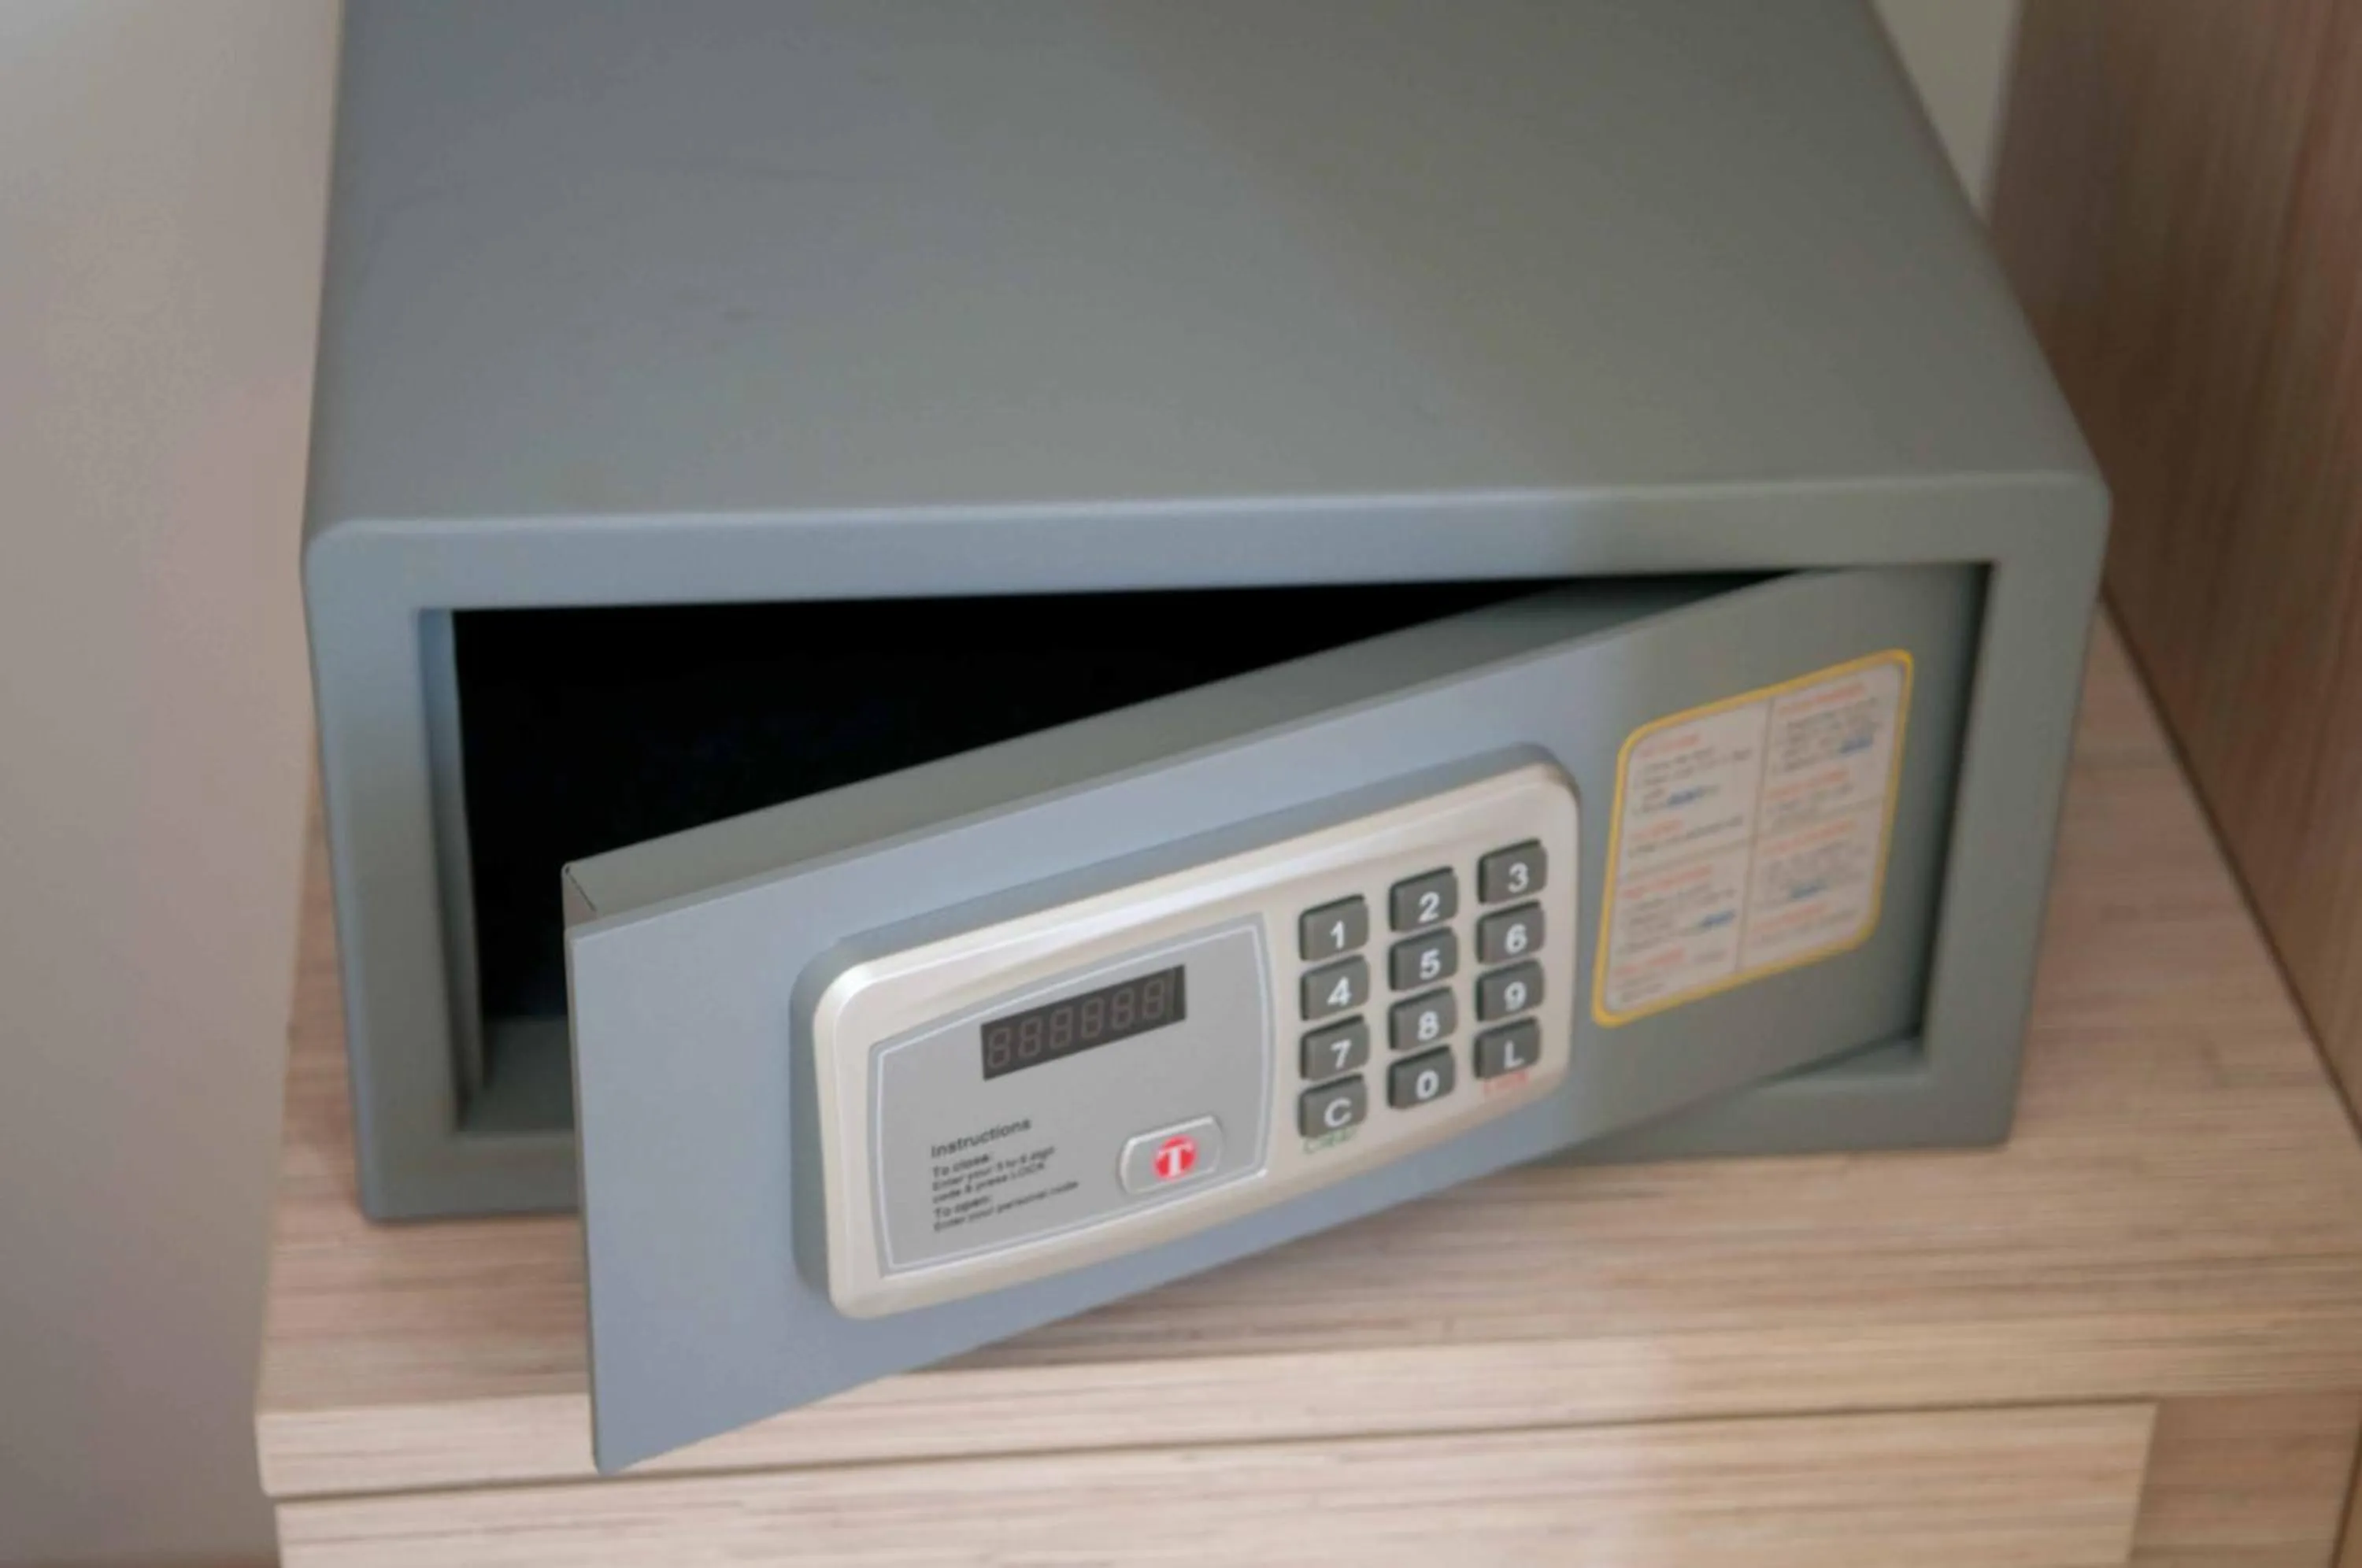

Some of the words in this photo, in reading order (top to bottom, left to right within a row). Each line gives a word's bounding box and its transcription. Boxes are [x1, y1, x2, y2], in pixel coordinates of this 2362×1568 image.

[1331, 921, 1345, 949] 1
[1420, 892, 1440, 923] 2
[1508, 863, 1529, 893] 3
[1327, 978, 1352, 1005] 4
[1420, 949, 1440, 979] 5
[1505, 924, 1527, 952] 6
[1331, 1040, 1352, 1068] 7
[1419, 1012, 1438, 1041] 8
[1505, 982, 1526, 1011] 9
[1324, 1099, 1352, 1128] C
[1505, 1041, 1524, 1068] L
[931, 1119, 1031, 1158] Instructions
